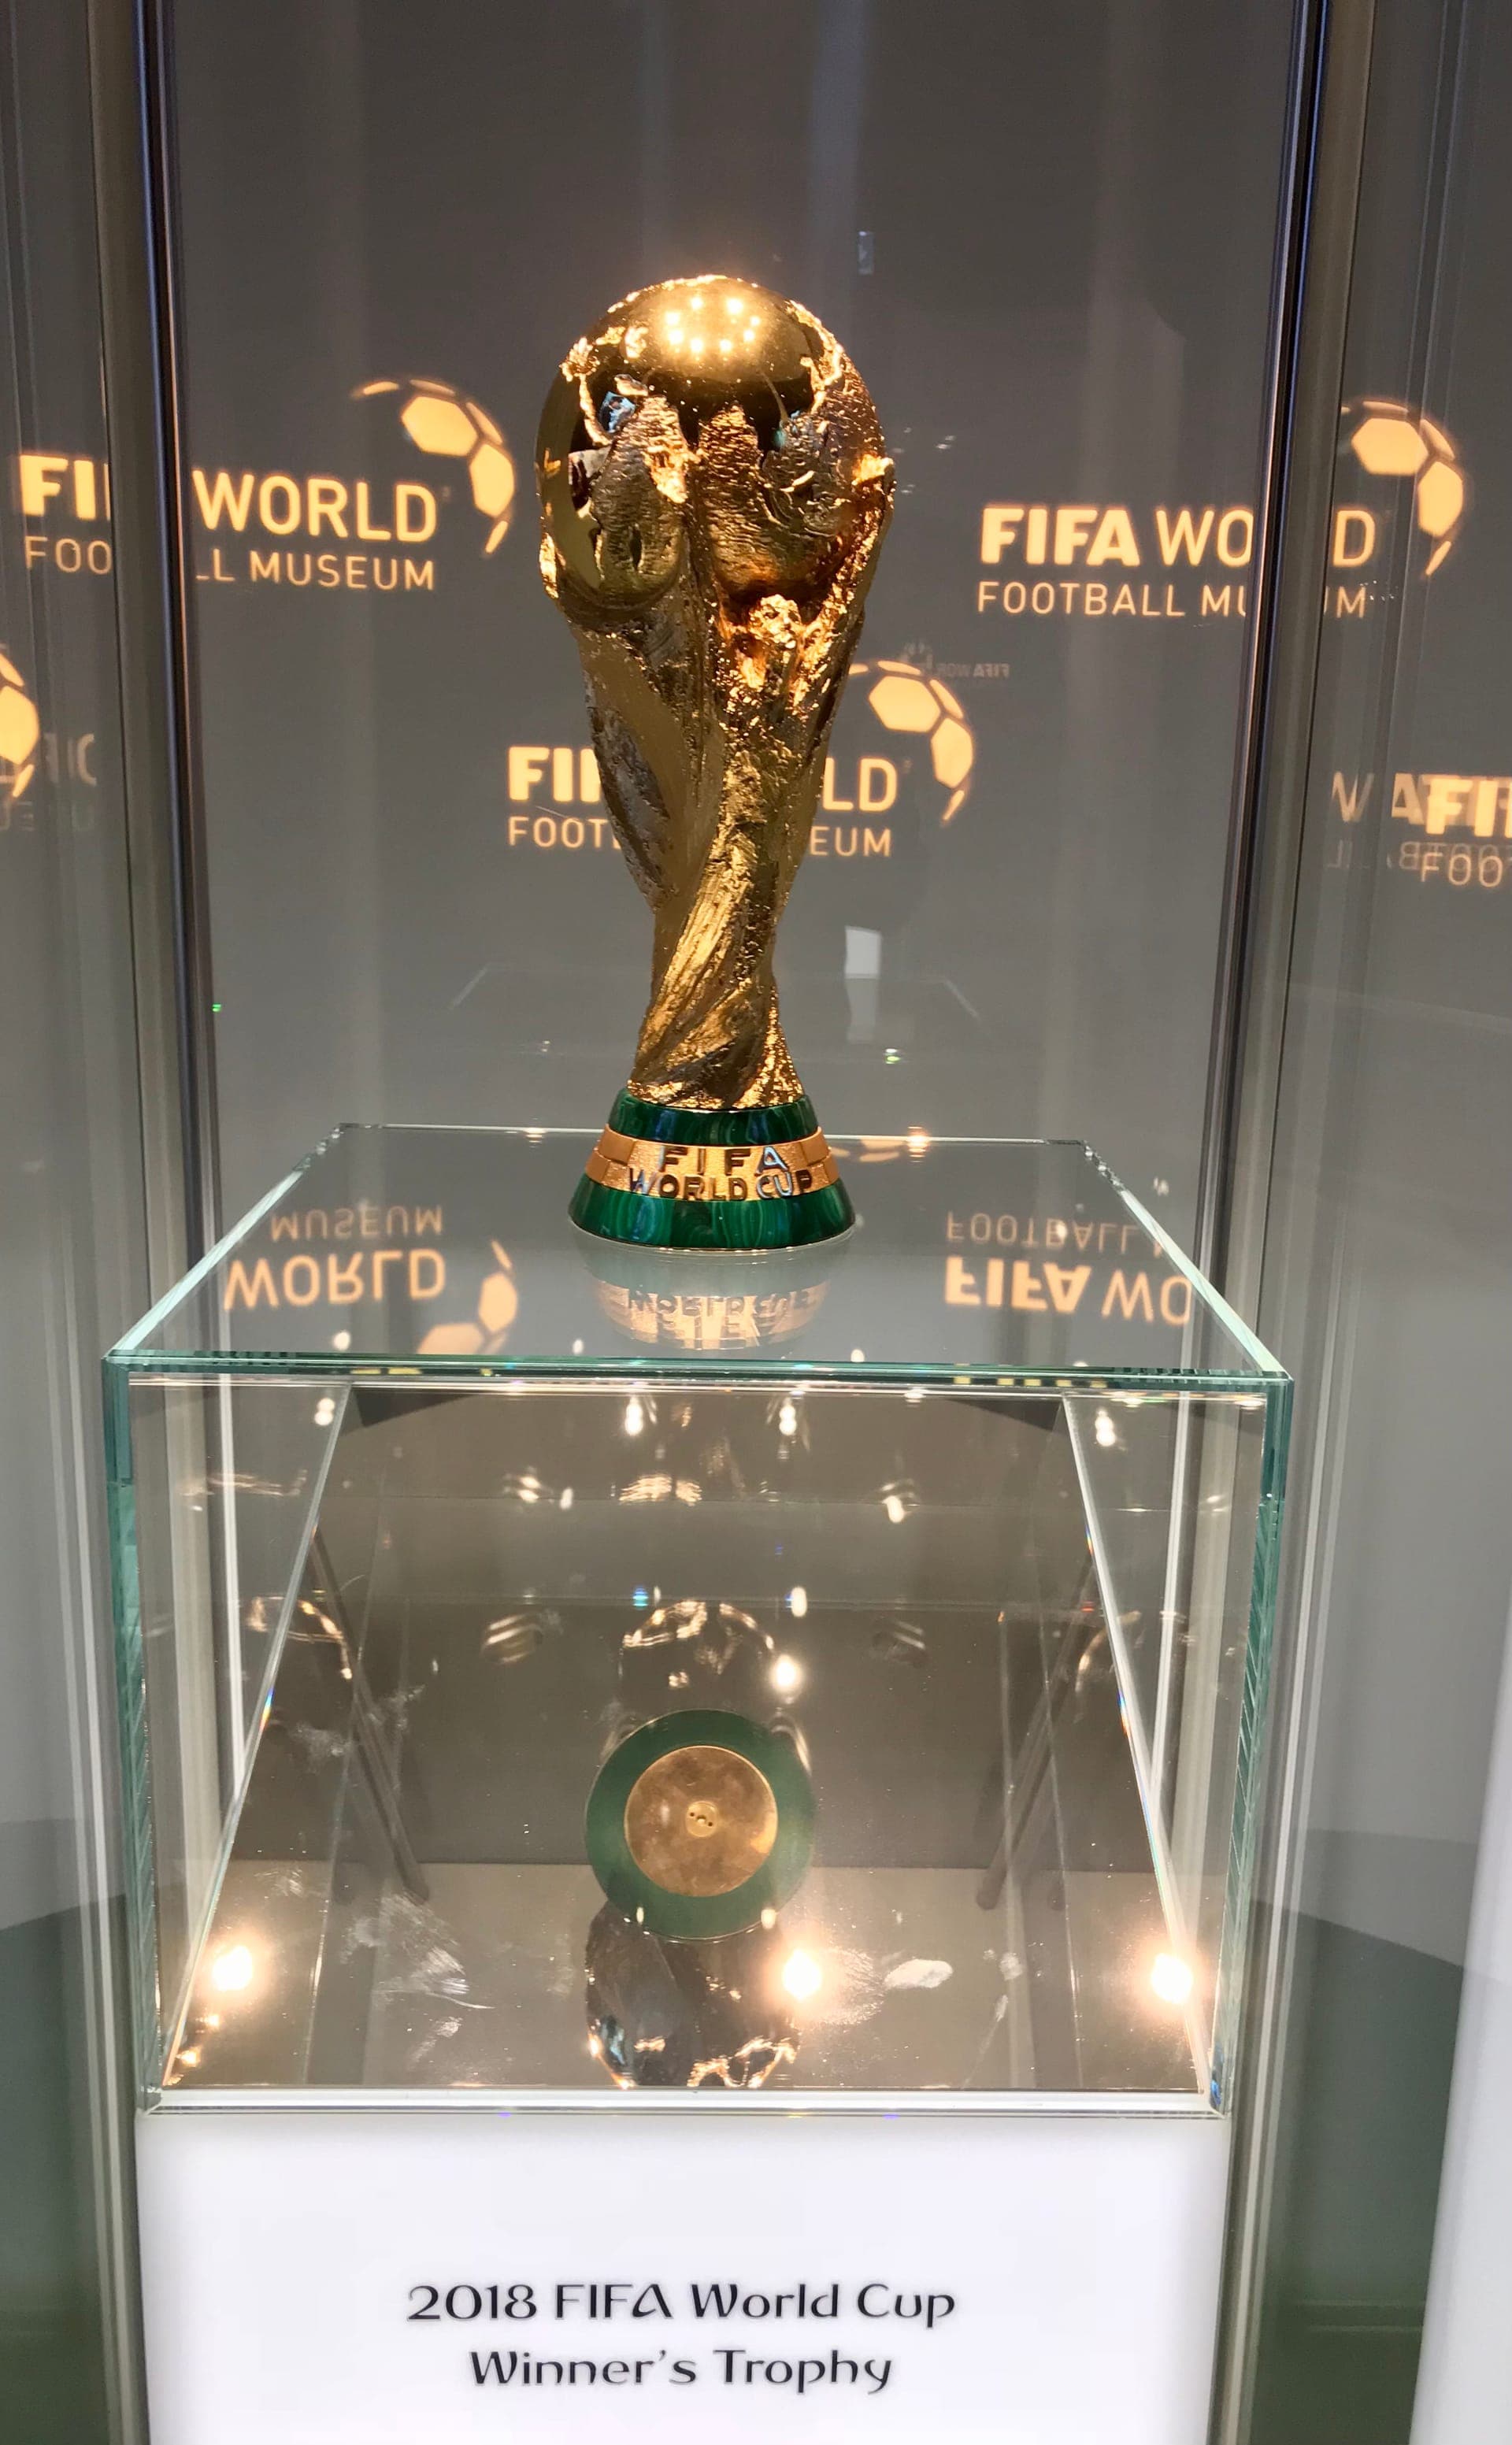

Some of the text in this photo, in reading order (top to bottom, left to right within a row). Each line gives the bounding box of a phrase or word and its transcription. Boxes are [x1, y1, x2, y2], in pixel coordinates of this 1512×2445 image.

[19, 453, 438, 543] FI WORLD
[980, 506, 1141, 566] FIFA
[250, 550, 435, 591] MUSEUM
[977, 580, 1186, 617] FOOTBALL
[821, 758, 899, 812] LD
[508, 816, 891, 858] FOOT EUM
[658, 1146, 788, 1176] FIFA
[629, 1168, 814, 1202] WORLD CUP
[406, 2284, 955, 2328] 2018 FIFA World Cup
[470, 2350, 892, 2395] Winner's Trophy
